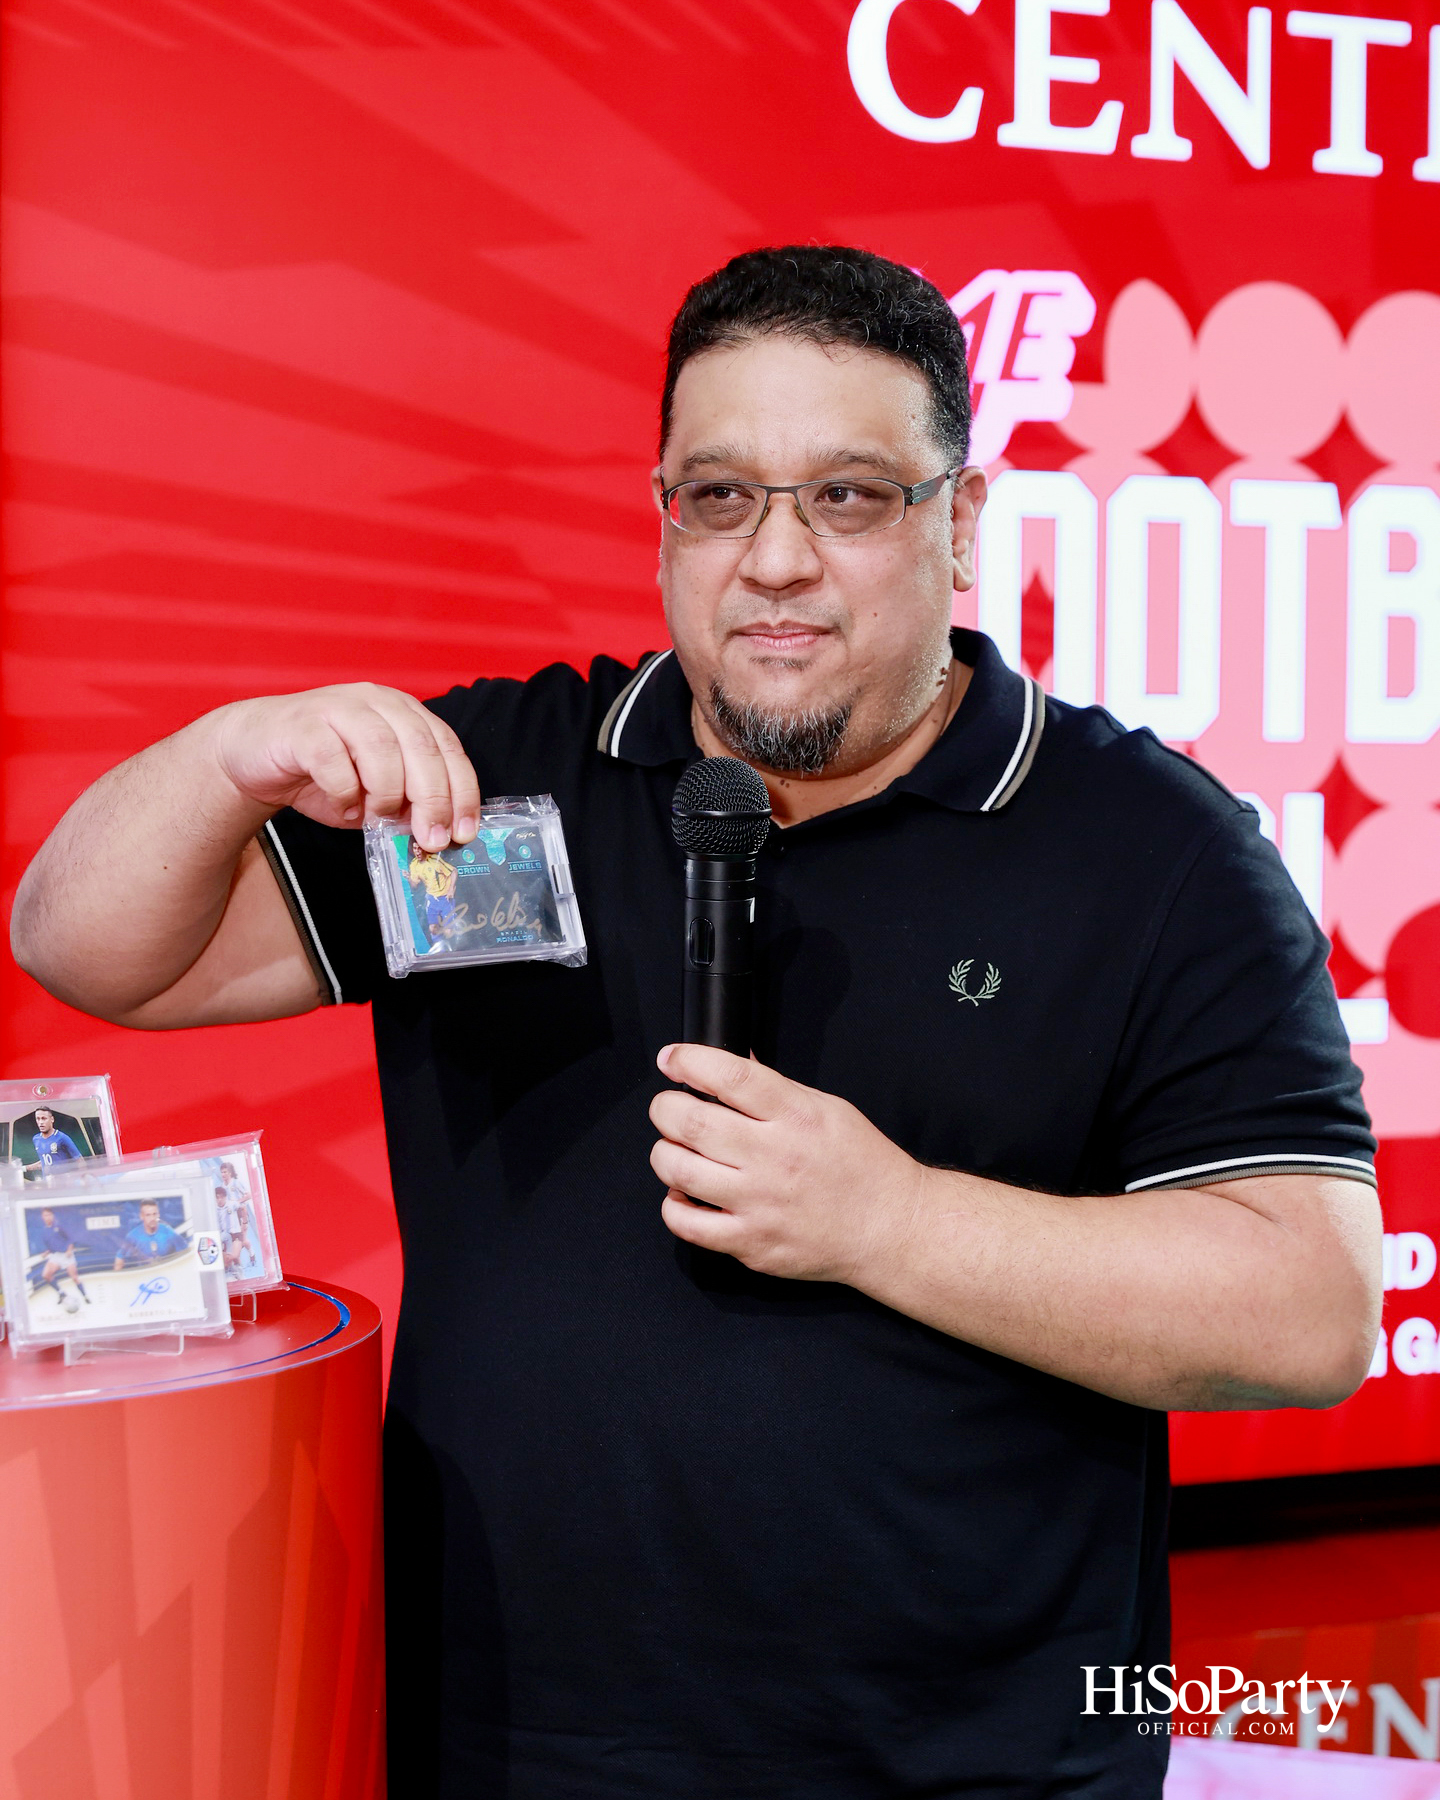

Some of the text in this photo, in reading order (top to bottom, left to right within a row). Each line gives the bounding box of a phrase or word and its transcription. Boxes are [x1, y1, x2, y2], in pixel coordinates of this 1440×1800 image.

[847, 0, 1440, 183] CENT
[457, 862, 542, 875] CROWN JEWELS
[496, 934, 534, 943] RONALDO
[42, 1153, 53, 1166] 10
